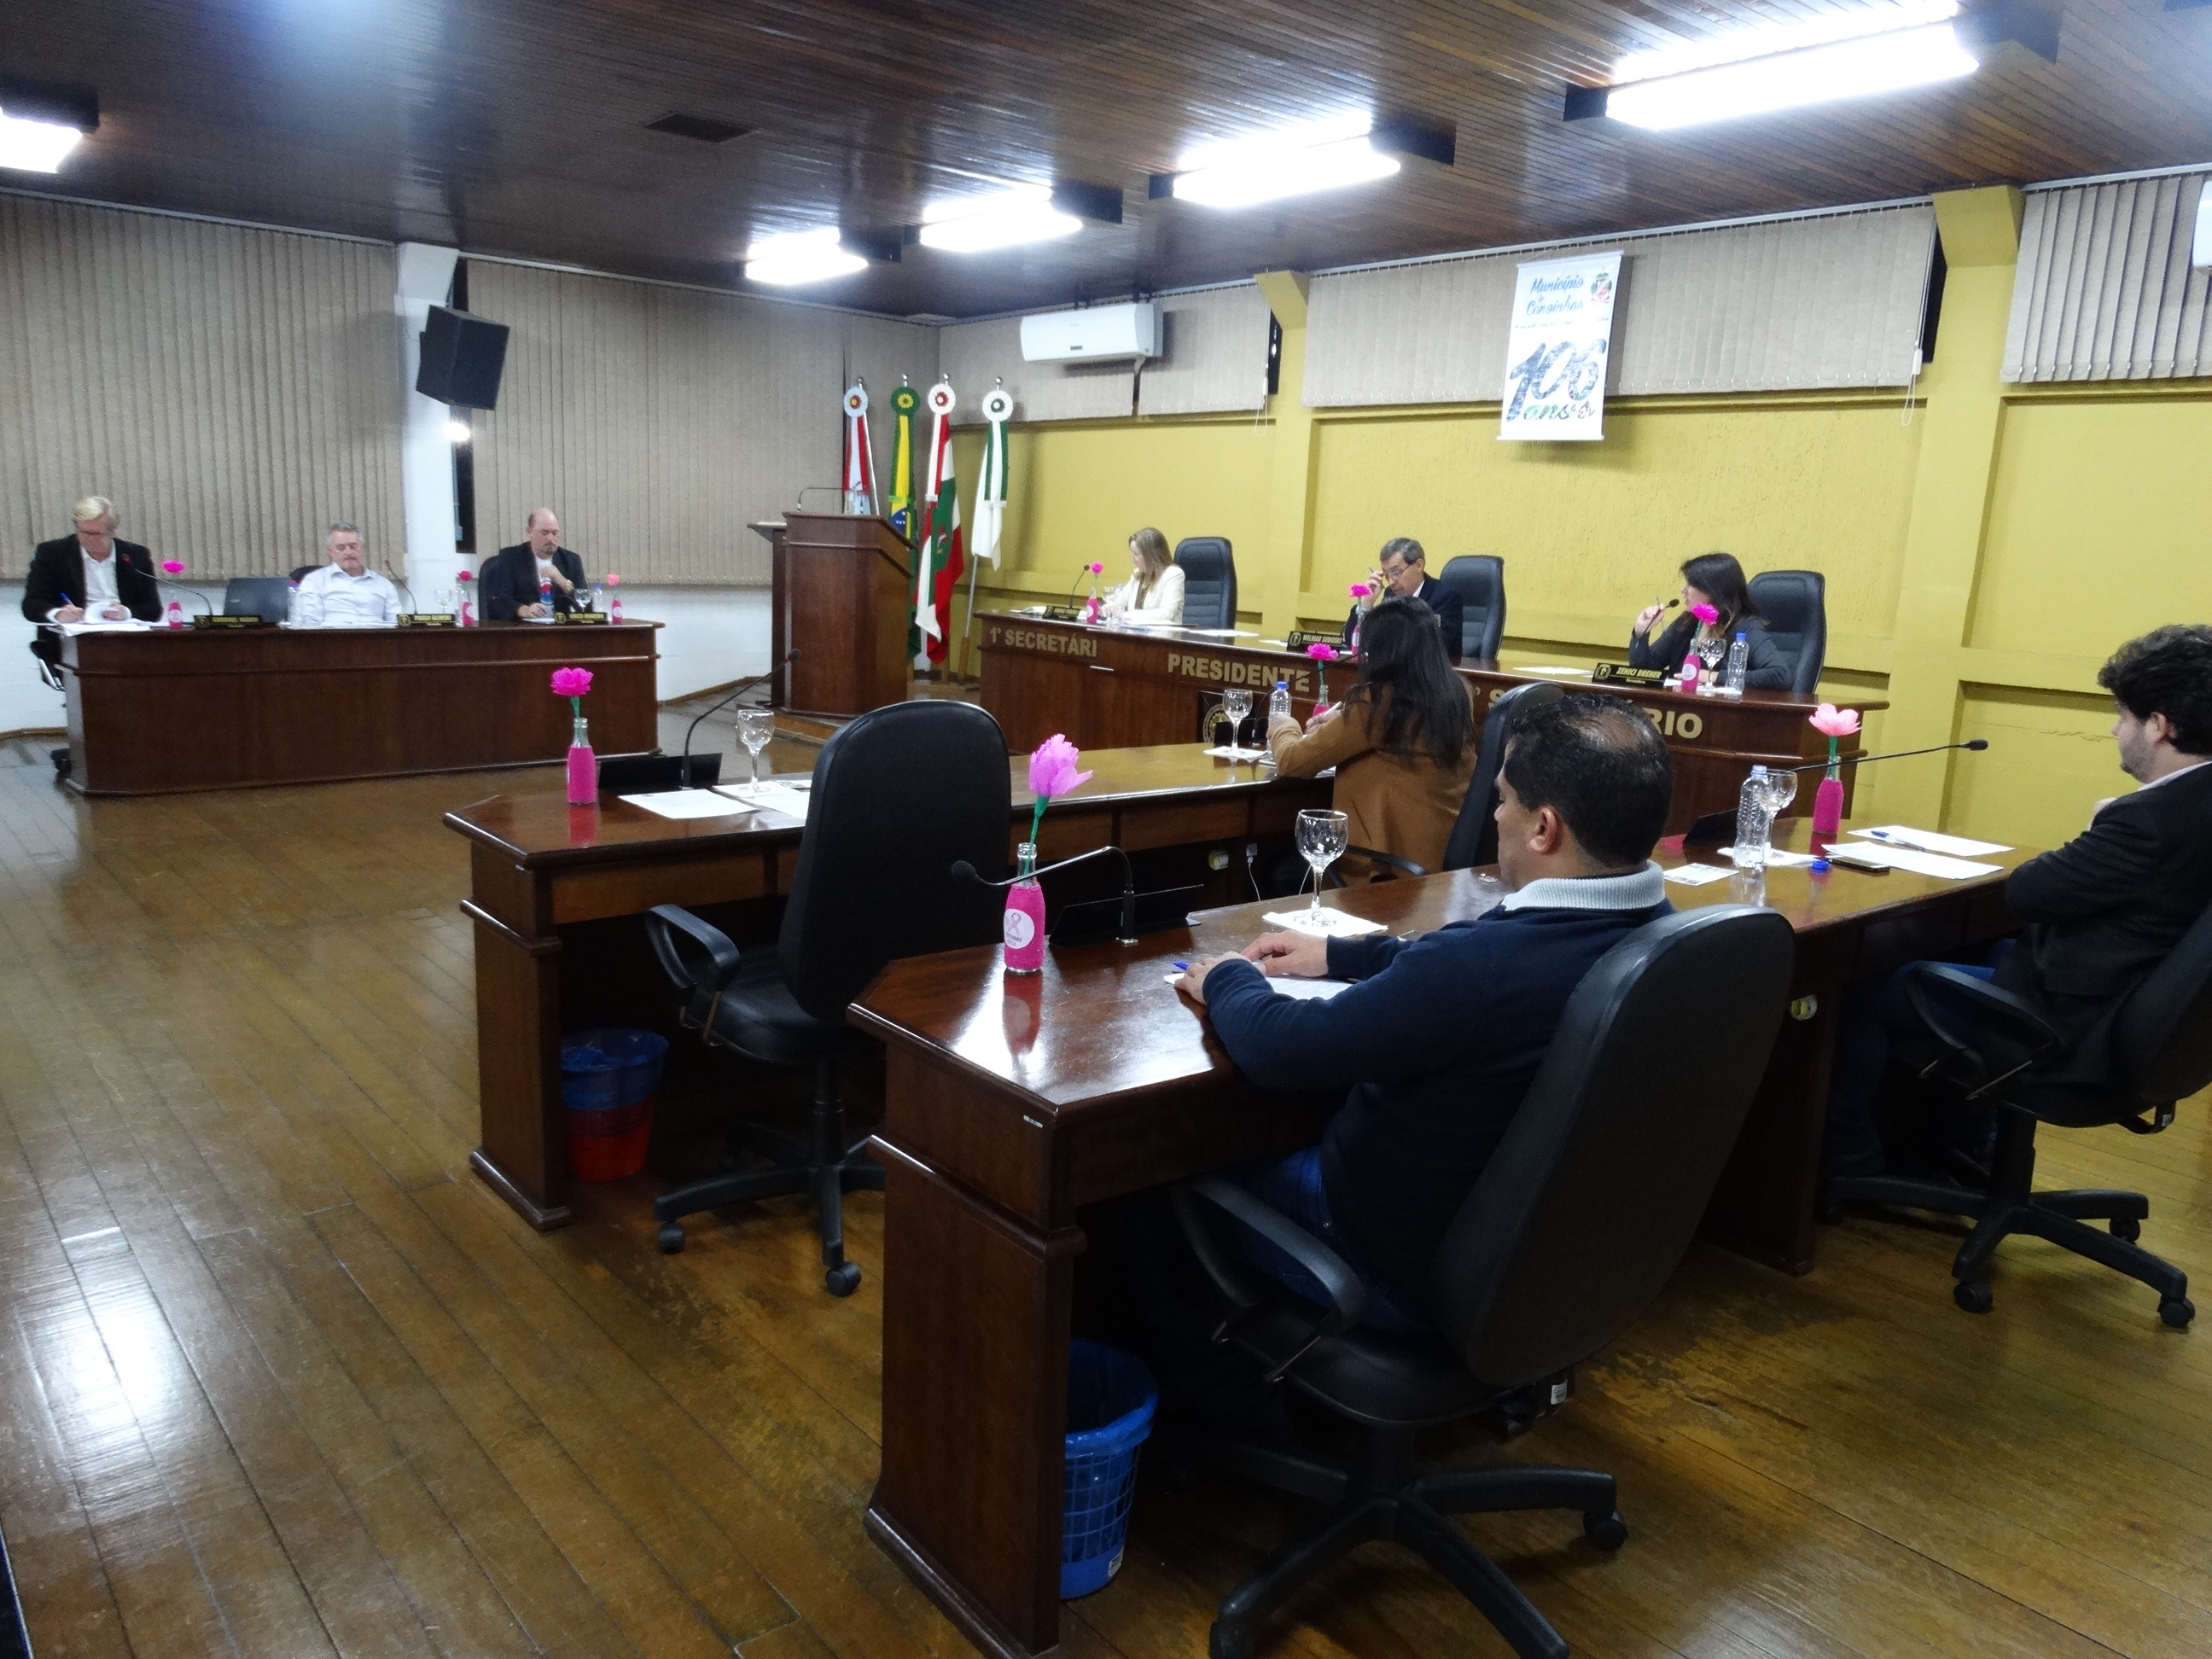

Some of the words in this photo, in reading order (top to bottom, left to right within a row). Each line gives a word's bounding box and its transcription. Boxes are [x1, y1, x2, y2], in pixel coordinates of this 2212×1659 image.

[1531, 274, 1584, 293] Município
[1167, 653, 1311, 693] PRESIDENTE
[1636, 668, 1662, 679] DREHER
